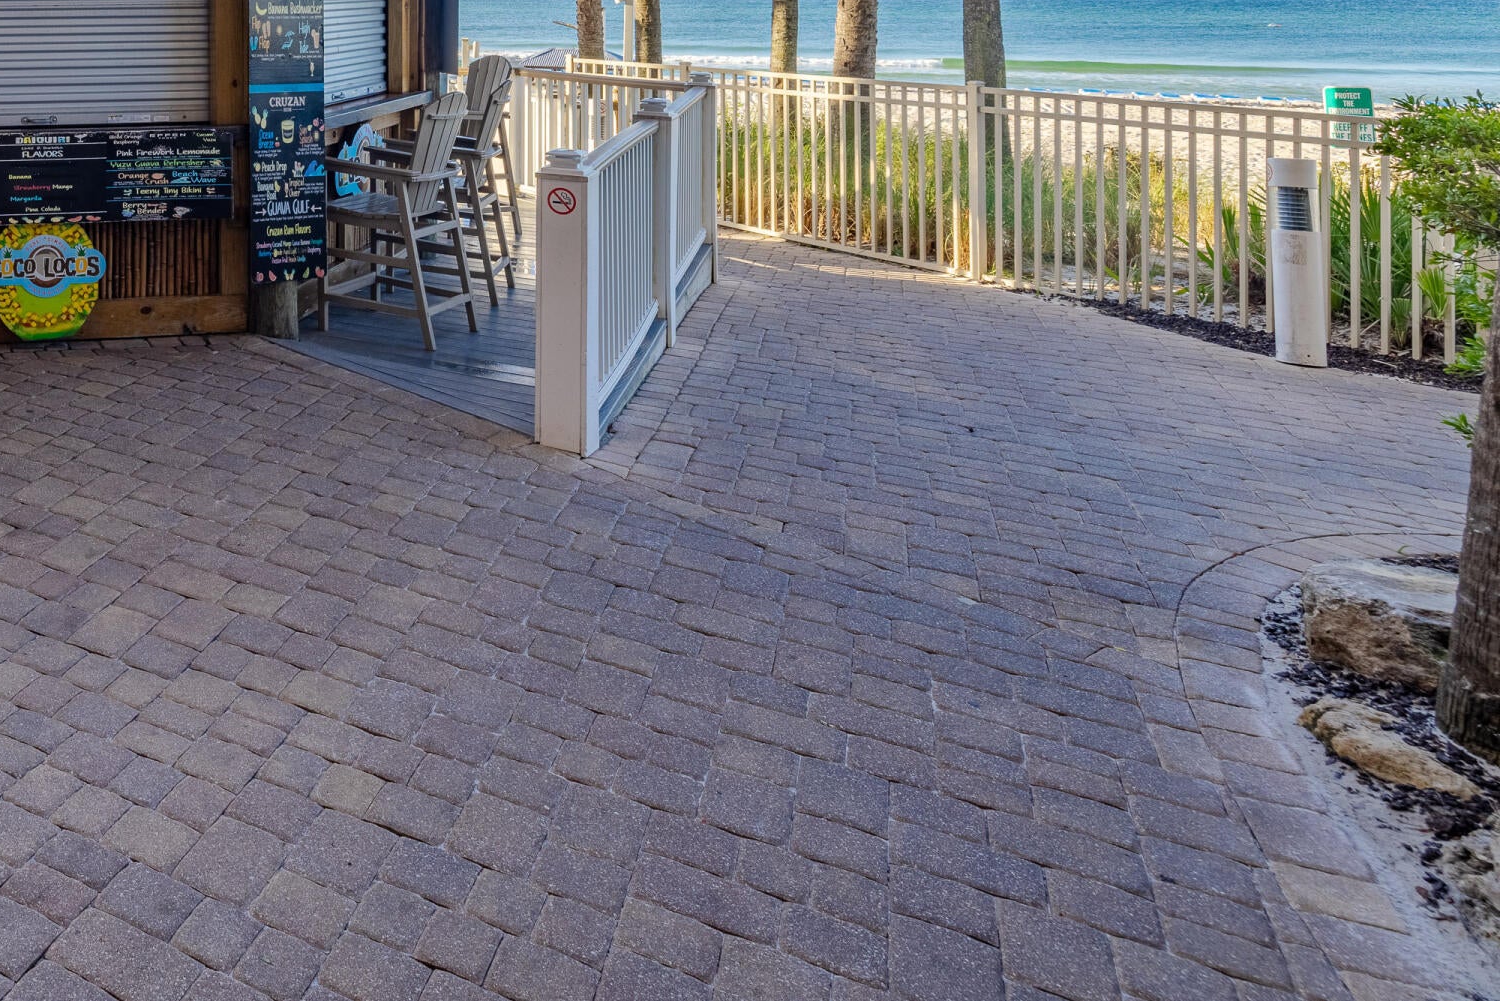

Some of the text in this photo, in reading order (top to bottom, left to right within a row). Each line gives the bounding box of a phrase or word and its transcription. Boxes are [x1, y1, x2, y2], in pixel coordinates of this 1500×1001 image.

[1334, 92, 1361, 100] PROTECT
[269, 96, 307, 108] CRUZAN
[15, 136, 71, 144] DAIQUIRI
[21, 150, 64, 158] FLAVORS
[116, 147, 221, 157] Pink Firework Lemonade
[163, 158, 205, 167] Refresher
[135, 186, 202, 197] Teeny Tiny Bikini
[122, 202, 147, 210] Berry
[44, 256, 100, 278] LOCOS
